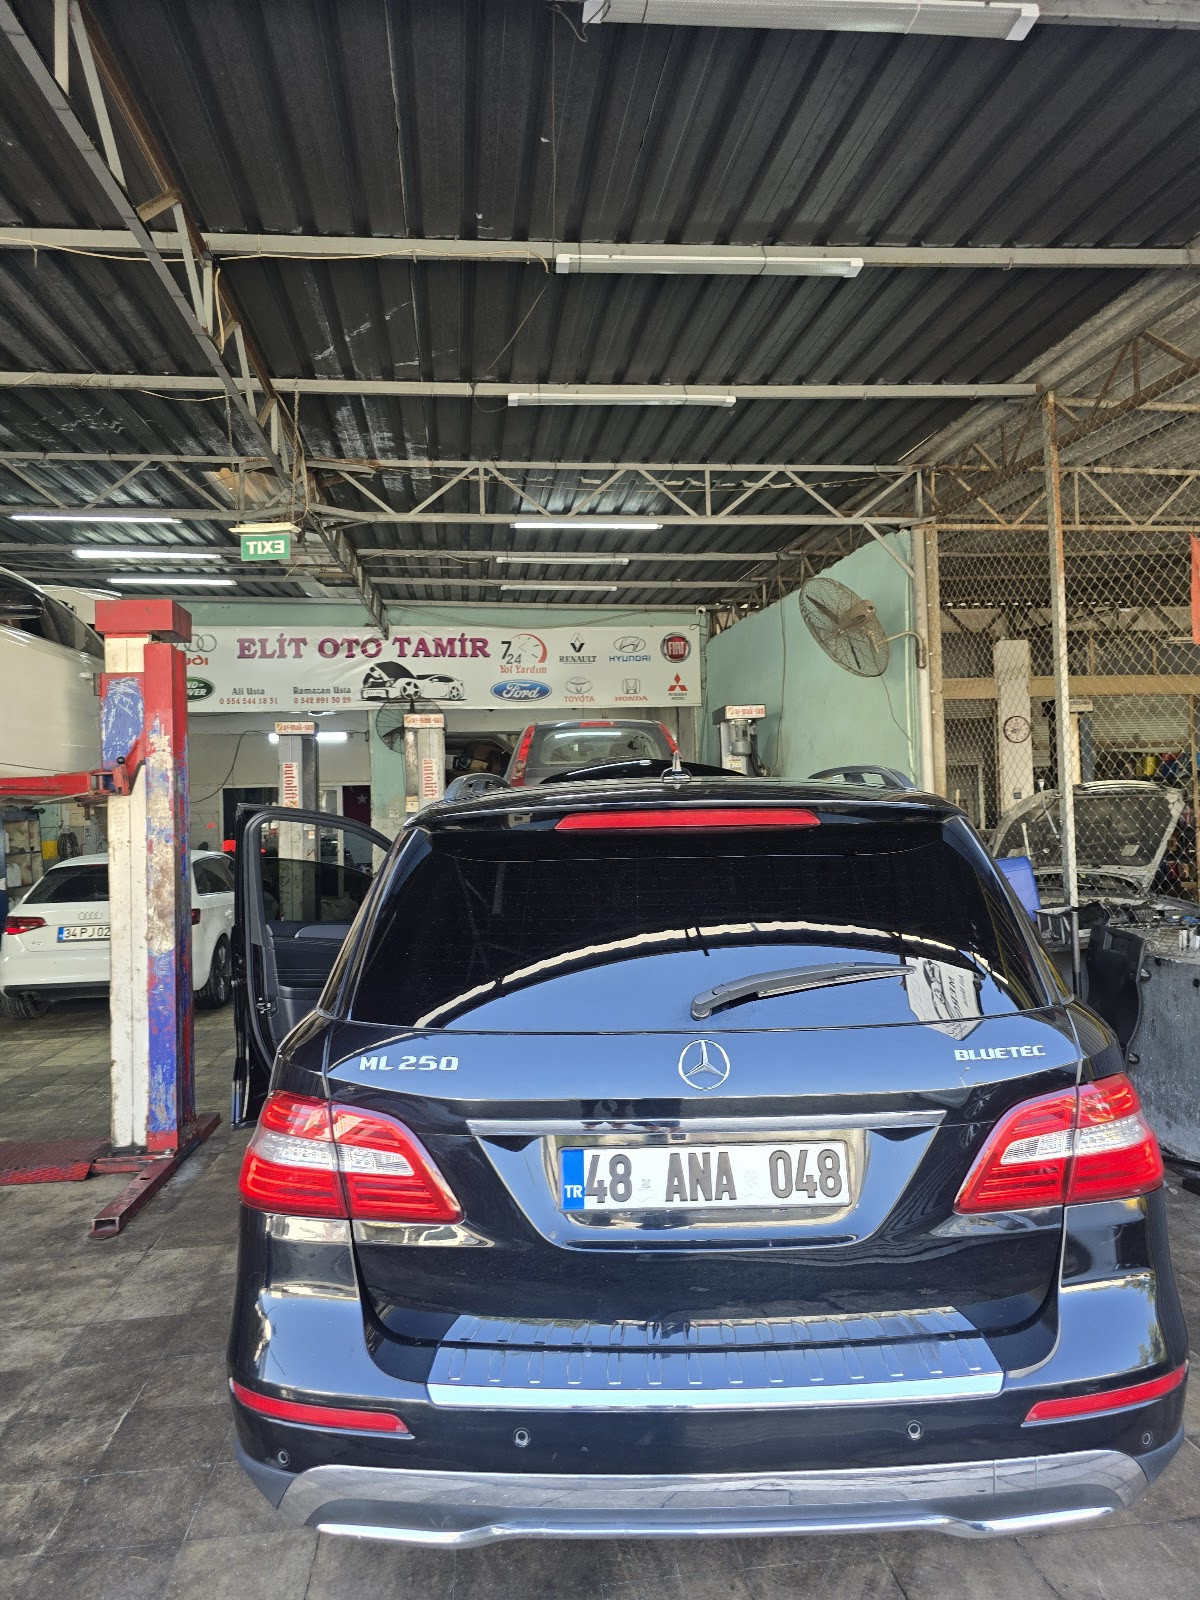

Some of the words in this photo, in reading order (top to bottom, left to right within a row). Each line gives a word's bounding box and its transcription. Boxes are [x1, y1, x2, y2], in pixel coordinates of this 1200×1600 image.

[237, 633, 308, 659] ELİT
[317, 637, 383, 659] OTO
[392, 633, 491, 659] TAMİR
[501, 641, 512, 660] 7
[667, 641, 686, 655] FIAT
[506, 653, 522, 665] 24
[559, 655, 598, 663] RENAULT
[608, 654, 652, 662] HYUNDAI
[500, 665, 513, 674] Yol
[231, 687, 245, 696] Ali
[293, 686, 331, 695] Ramazan
[333, 686, 352, 694] Usta
[502, 682, 540, 699] Ford
[65, 928, 77, 938] 34
[97, 926, 110, 937] 02
[954, 1045, 1046, 1061] BLUETEC
[360, 1055, 395, 1071] ML
[398, 1055, 459, 1071] 250
[564, 1184, 583, 1198] TR
[585, 1153, 633, 1204] 48
[665, 1151, 737, 1202] ANA
[768, 1148, 843, 1199] 048
